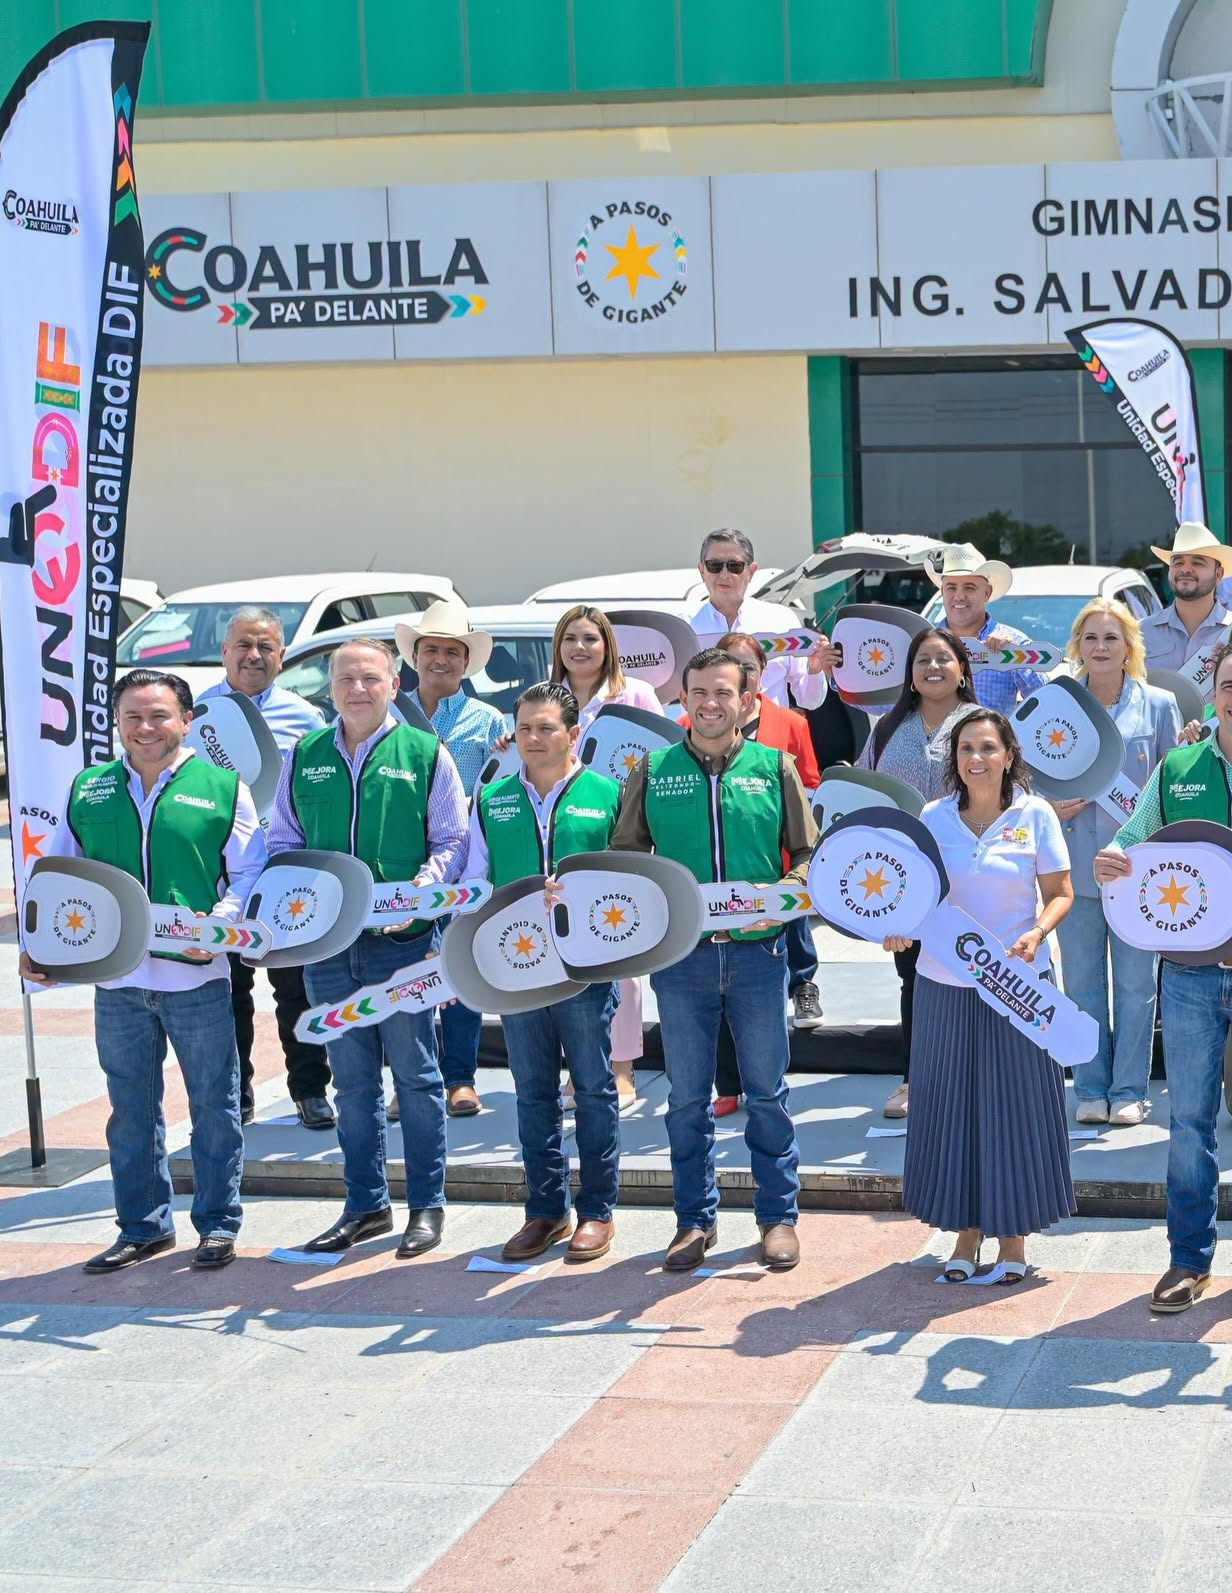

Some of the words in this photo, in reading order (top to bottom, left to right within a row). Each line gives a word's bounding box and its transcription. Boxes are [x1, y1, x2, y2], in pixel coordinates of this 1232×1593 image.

[3, 190, 79, 224] COAHUILA
[589, 214, 604, 230] A
[605, 201, 672, 227] PASOS
[40, 222, 66, 234] DELANTE
[145, 227, 489, 312] COAHUILA
[102, 261, 139, 339] DIF
[576, 280, 600, 309] DE
[602, 280, 687, 324] GIGANTE
[848, 274, 965, 319] ING.
[311, 298, 429, 323] DELANTE
[1127, 349, 1171, 383] COAHUILA
[1116, 399, 1157, 453] Unidad
[87, 352, 134, 640] Especializada
[868, 638, 890, 647] PASOS
[618, 651, 666, 664] OAHUILA
[857, 661, 866, 673] DE
[865, 661, 896, 676] GIGANTE
[84, 655, 110, 767] nidad
[1035, 729, 1041, 741] DE
[1061, 719, 1078, 741] PASOS
[627, 742, 647, 753] PASO
[1036, 741, 1067, 760] GIGANTE
[378, 766, 417, 779] COAHUILA
[649, 774, 702, 786] GABRIEL
[731, 776, 772, 788] MEJORA
[655, 789, 694, 797] SENADOR
[1169, 783, 1206, 795] MEJORA
[173, 793, 216, 808] COAHUILA
[19, 806, 58, 827] ASOS
[864, 852, 872, 861] A
[875, 852, 908, 878] PASOS
[1148, 866, 1159, 878] A
[1158, 861, 1201, 879] PASOS
[285, 890, 291, 898] A
[292, 887, 317, 898] PASOS
[595, 898, 602, 906] A
[602, 893, 633, 904] PASOS
[839, 879, 849, 896] DE
[845, 897, 897, 918] GIGANTE
[61, 901, 67, 909] A
[67, 898, 93, 911] PASOS
[273, 914, 281, 927] DE
[280, 912, 315, 931] GIGANTE
[1138, 904, 1154, 922] DE
[1155, 903, 1208, 932] GIGANTE
[53, 925, 61, 939] DE
[62, 929, 96, 947] GIGANTE
[498, 920, 529, 949] GIGANTE
[589, 925, 600, 938] DE
[602, 920, 641, 943] GIGANTE
[512, 957, 542, 970] PASOS
[955, 931, 1057, 1025] COAHUILA
[996, 987, 1031, 1019] DELANTE
